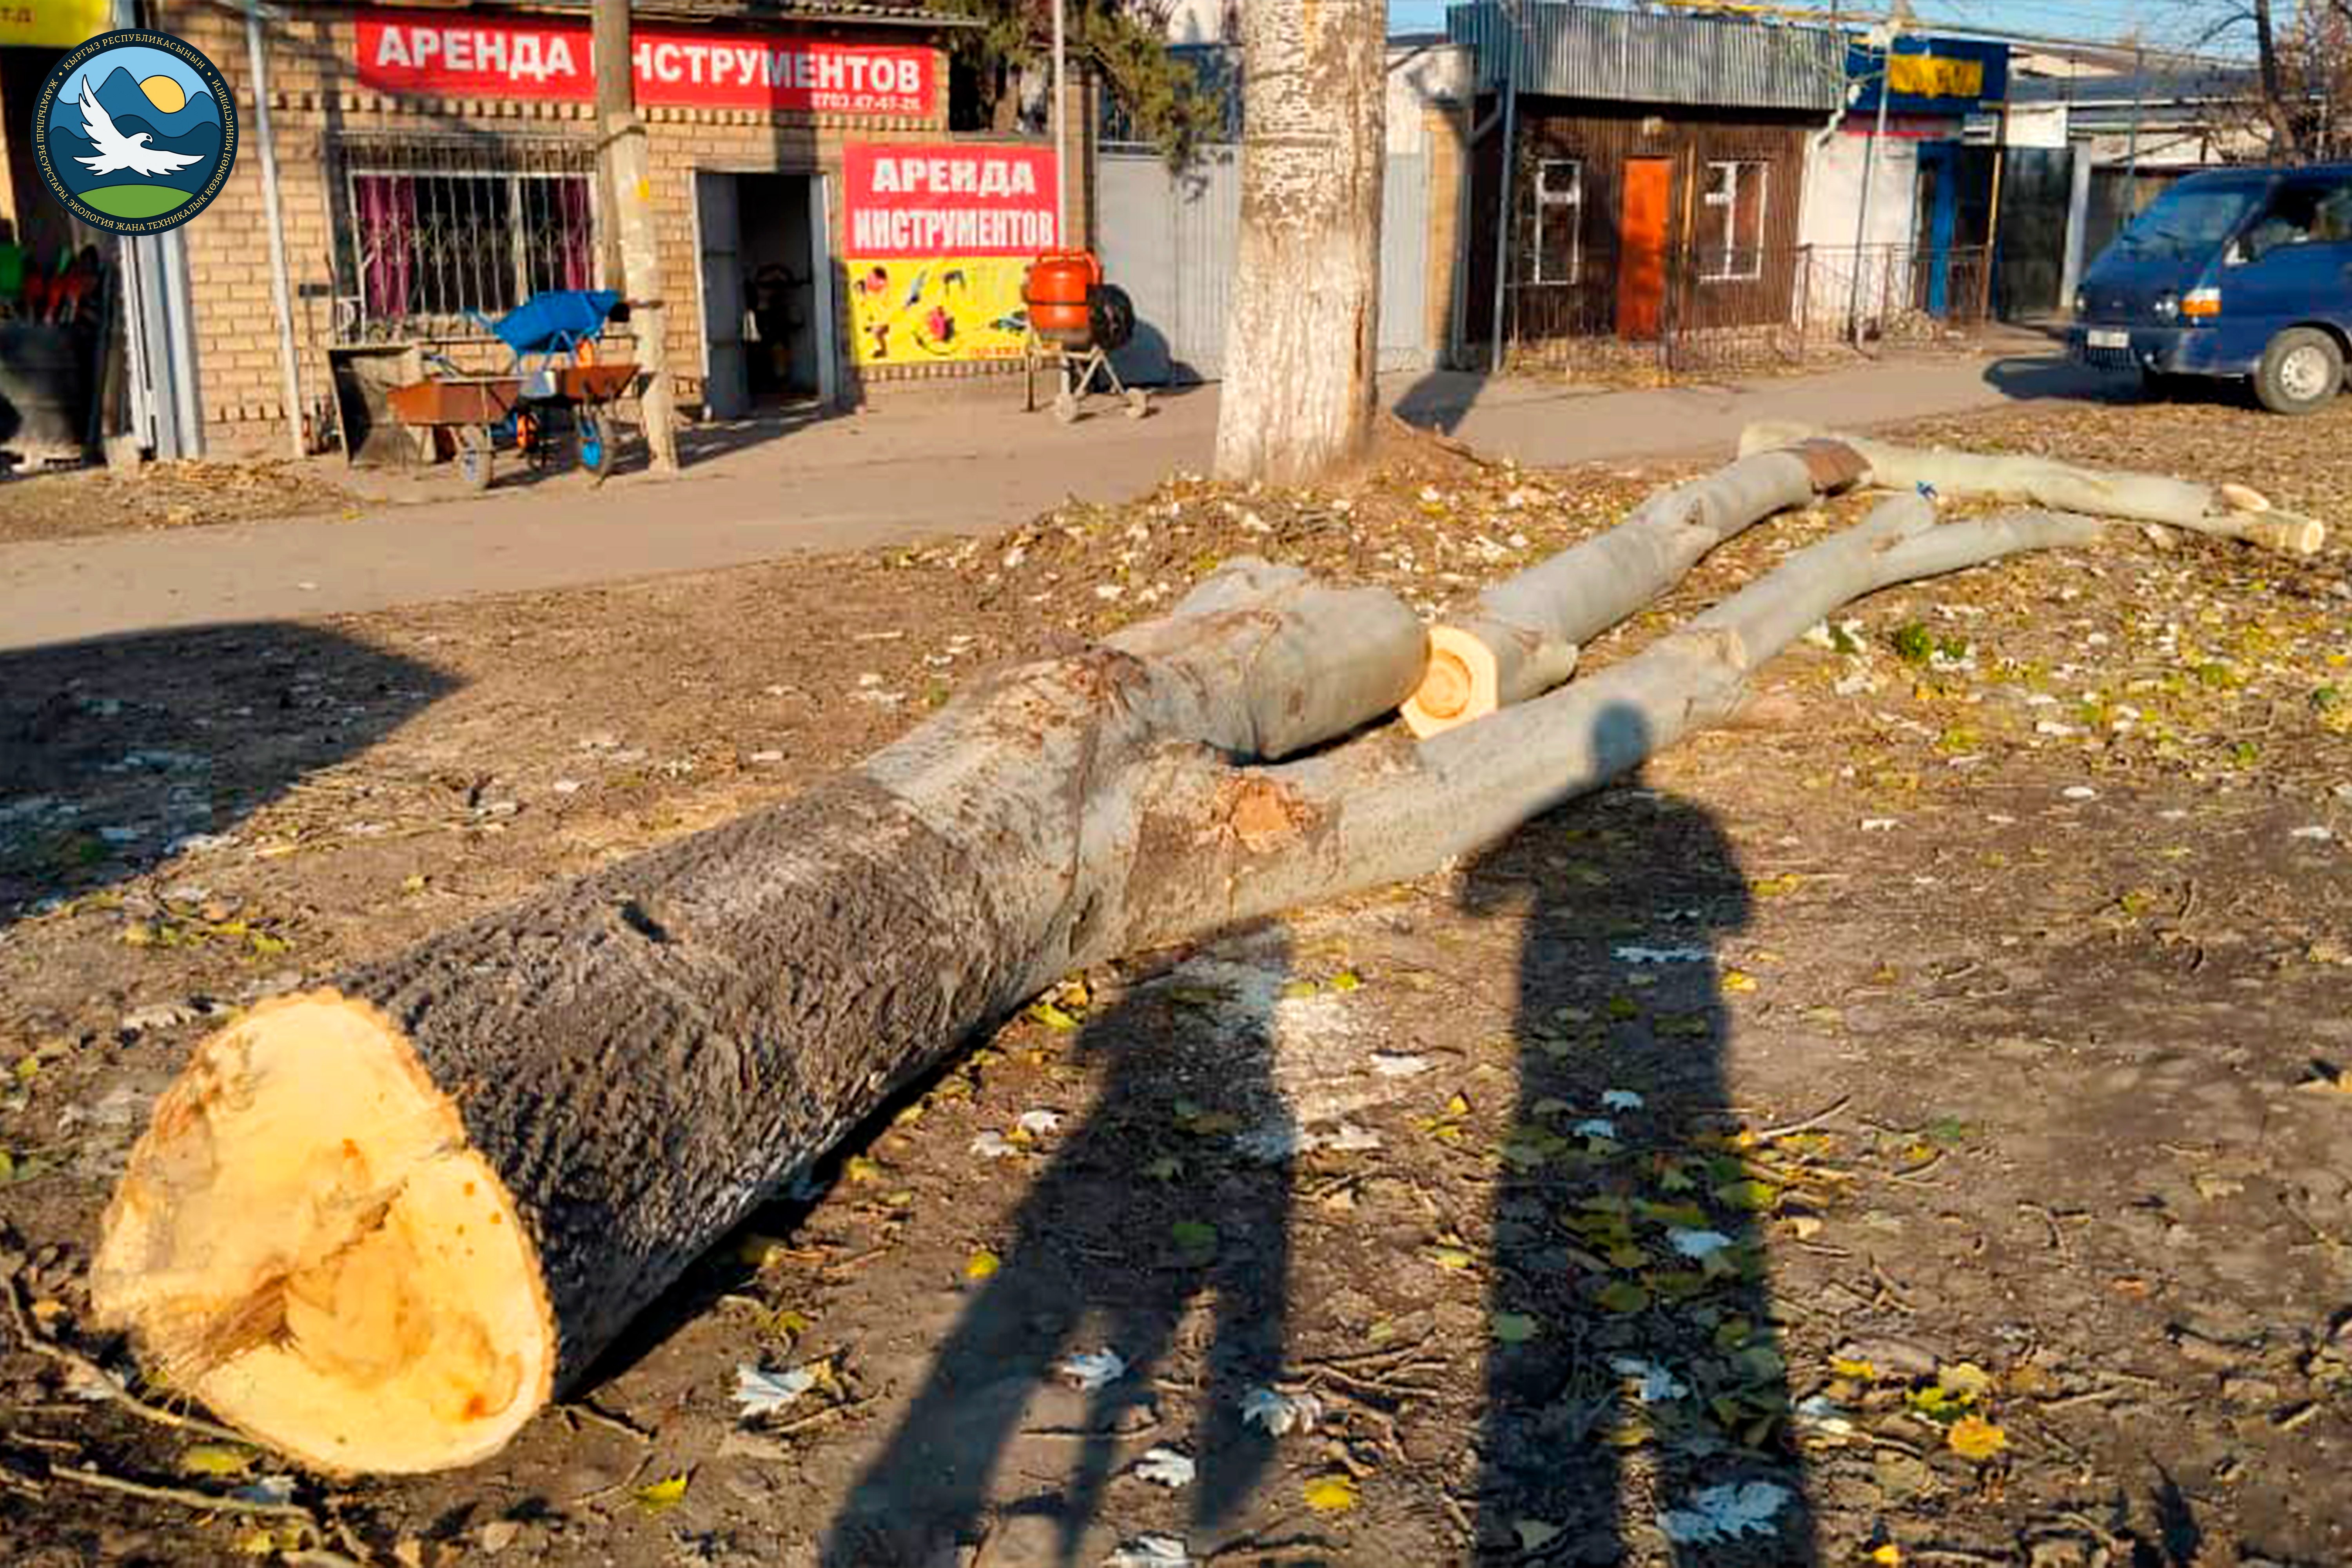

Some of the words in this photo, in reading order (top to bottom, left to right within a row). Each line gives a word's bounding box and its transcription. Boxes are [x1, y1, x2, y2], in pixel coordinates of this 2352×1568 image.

[376, 25, 576, 82] АРЕНДА
[590, 40, 920, 93] НСТРУМЕНТОВ
[872, 158, 1036, 197] АРЕНДА
[853, 208, 1054, 249] ИНСТРУМЕНТОВ
